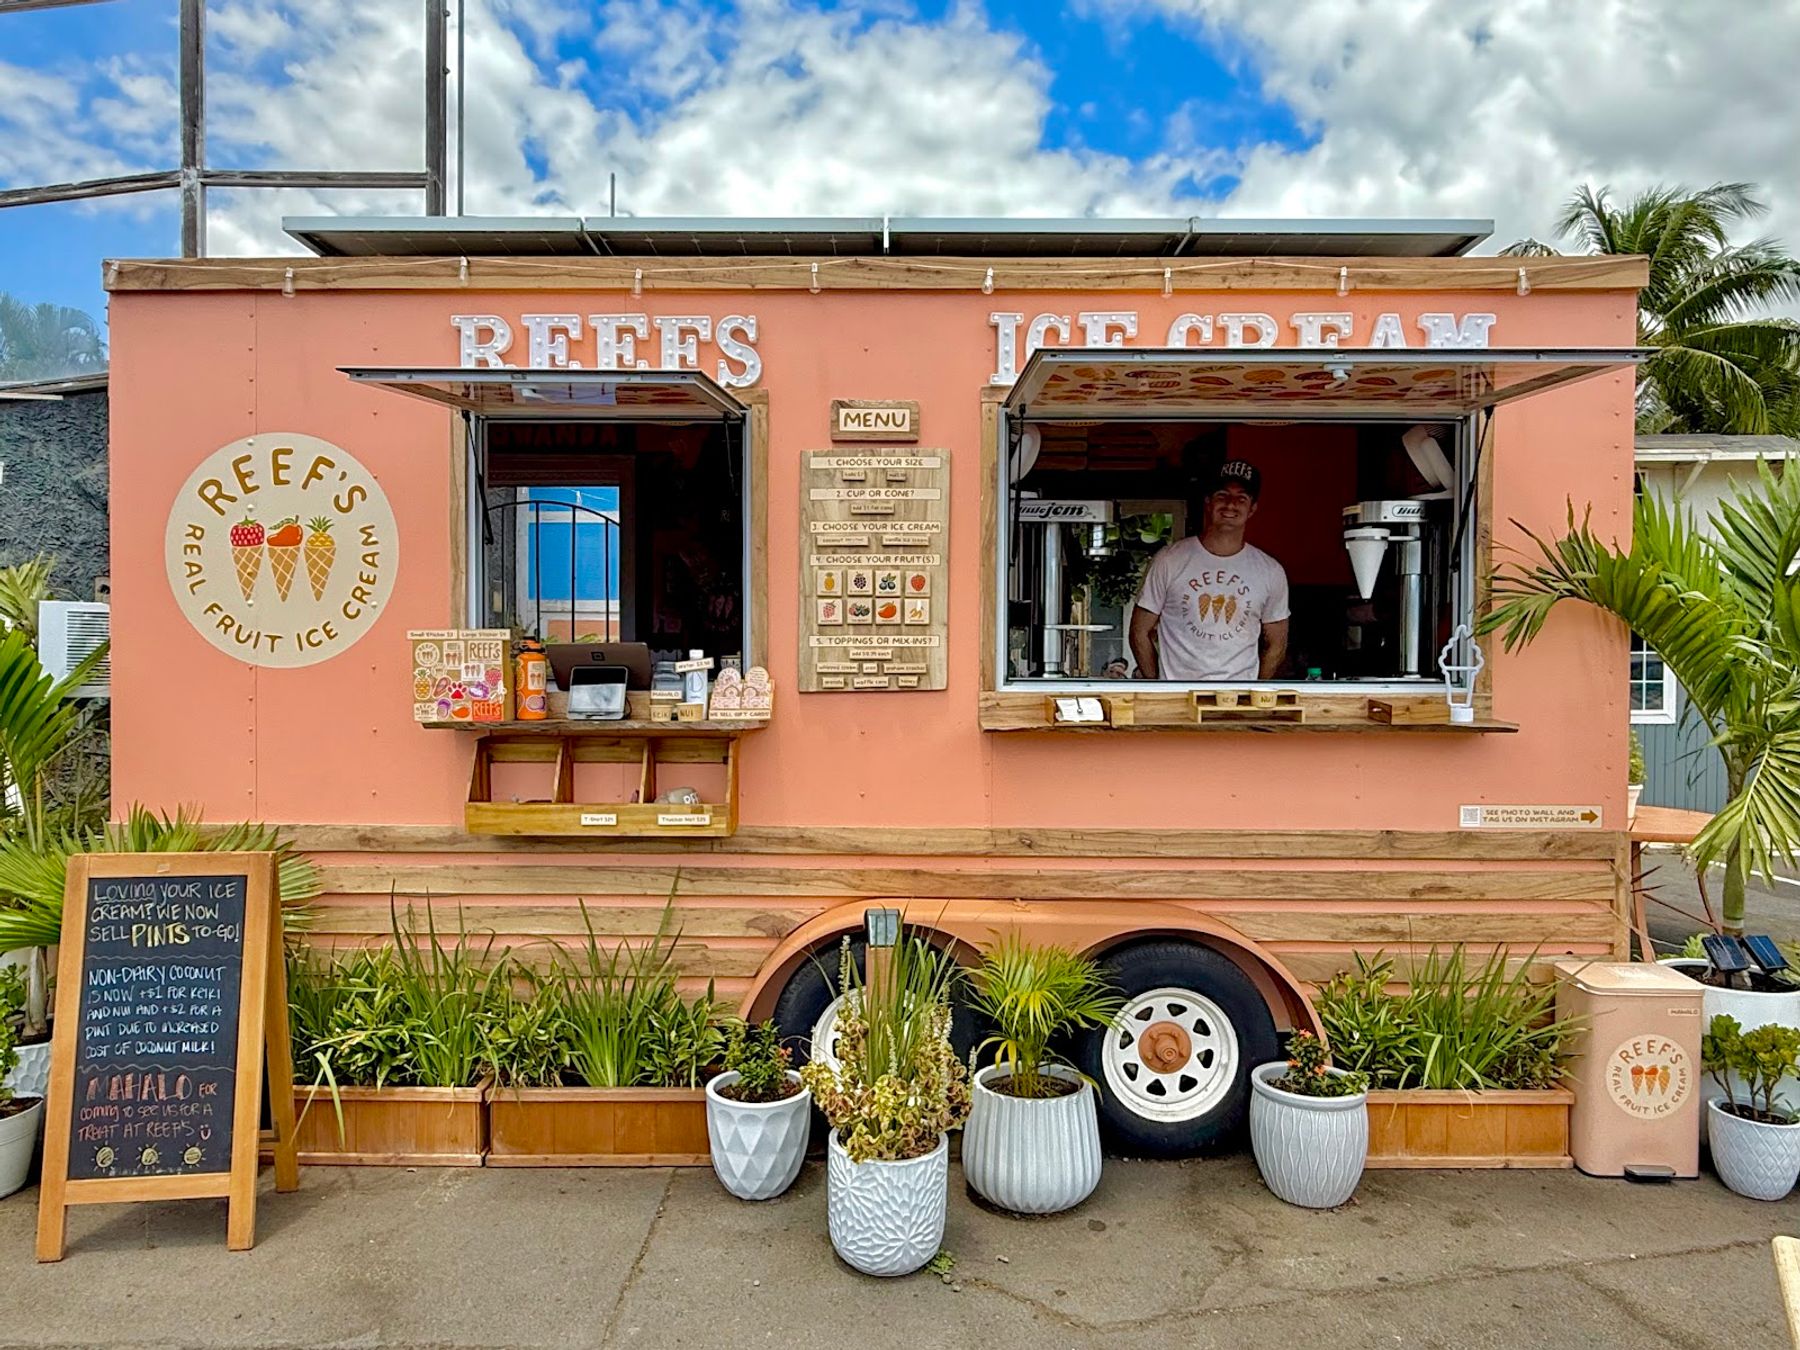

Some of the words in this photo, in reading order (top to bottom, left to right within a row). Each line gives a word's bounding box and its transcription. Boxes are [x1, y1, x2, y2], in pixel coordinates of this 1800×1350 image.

[843, 412, 906, 428] MENU
[836, 458, 872, 466] CHOOSE
[876, 458, 902, 466] YOUR
[905, 458, 924, 466] SIZE
[197, 448, 367, 516] REEF'S
[822, 523, 858, 531] CHOOSE
[862, 523, 888, 531] YOUR
[890, 523, 904, 531] ICE
[907, 523, 940, 531] CREAM
[826, 555, 862, 563] CHOOSE
[865, 555, 891, 563] YOUR
[894, 555, 935, 564] FRUIT(S)
[183, 524, 207, 596] REAL
[203, 602, 284, 653] FRUIT
[296, 621, 339, 652] ICE
[342, 524, 380, 620] CREAM
[1188, 570, 1251, 596] REEF'S
[829, 637, 874, 645] TOPPINGS
[876, 637, 890, 645] OR
[209, 882, 238, 899] ICE
[90, 903, 155, 923] CREAM?
[157, 903, 182, 920] WE
[185, 902, 219, 920] NOW
[88, 924, 130, 942] SELL
[131, 921, 191, 948] PINTS
[89, 965, 166, 986] NON-DAIRY
[169, 965, 226, 982] COCONUT
[88, 989, 101, 1005] IS
[103, 985, 134, 1002] NOW
[167, 986, 187, 999] FOR
[86, 1007, 111, 1021] AND
[136, 1005, 159, 1016] AND
[190, 1005, 208, 1016] FOR
[212, 1005, 222, 1016] A
[85, 1023, 112, 1041] PINT
[118, 1021, 141, 1035] DUE
[144, 1021, 157, 1034] TO
[85, 1044, 111, 1060] COST
[114, 1041, 132, 1056] OF
[135, 1041, 181, 1055] COCONUT
[181, 1041, 215, 1055] MILK!
[1618, 1039, 1683, 1065] REEF'S
[86, 1073, 192, 1103] MAHALO
[198, 1083, 218, 1098] FOR
[1612, 1065, 1623, 1093] REAL
[1619, 1094, 1650, 1114] FRUIT
[1653, 1102, 1671, 1114] ICE
[1671, 1067, 1687, 1103] CREAM
[162, 1104, 179, 1116] US
[179, 1103, 200, 1116] FOR
[203, 1104, 213, 1116] A
[78, 1124, 119, 1142] TREAT
[123, 1122, 144, 1139] AT
